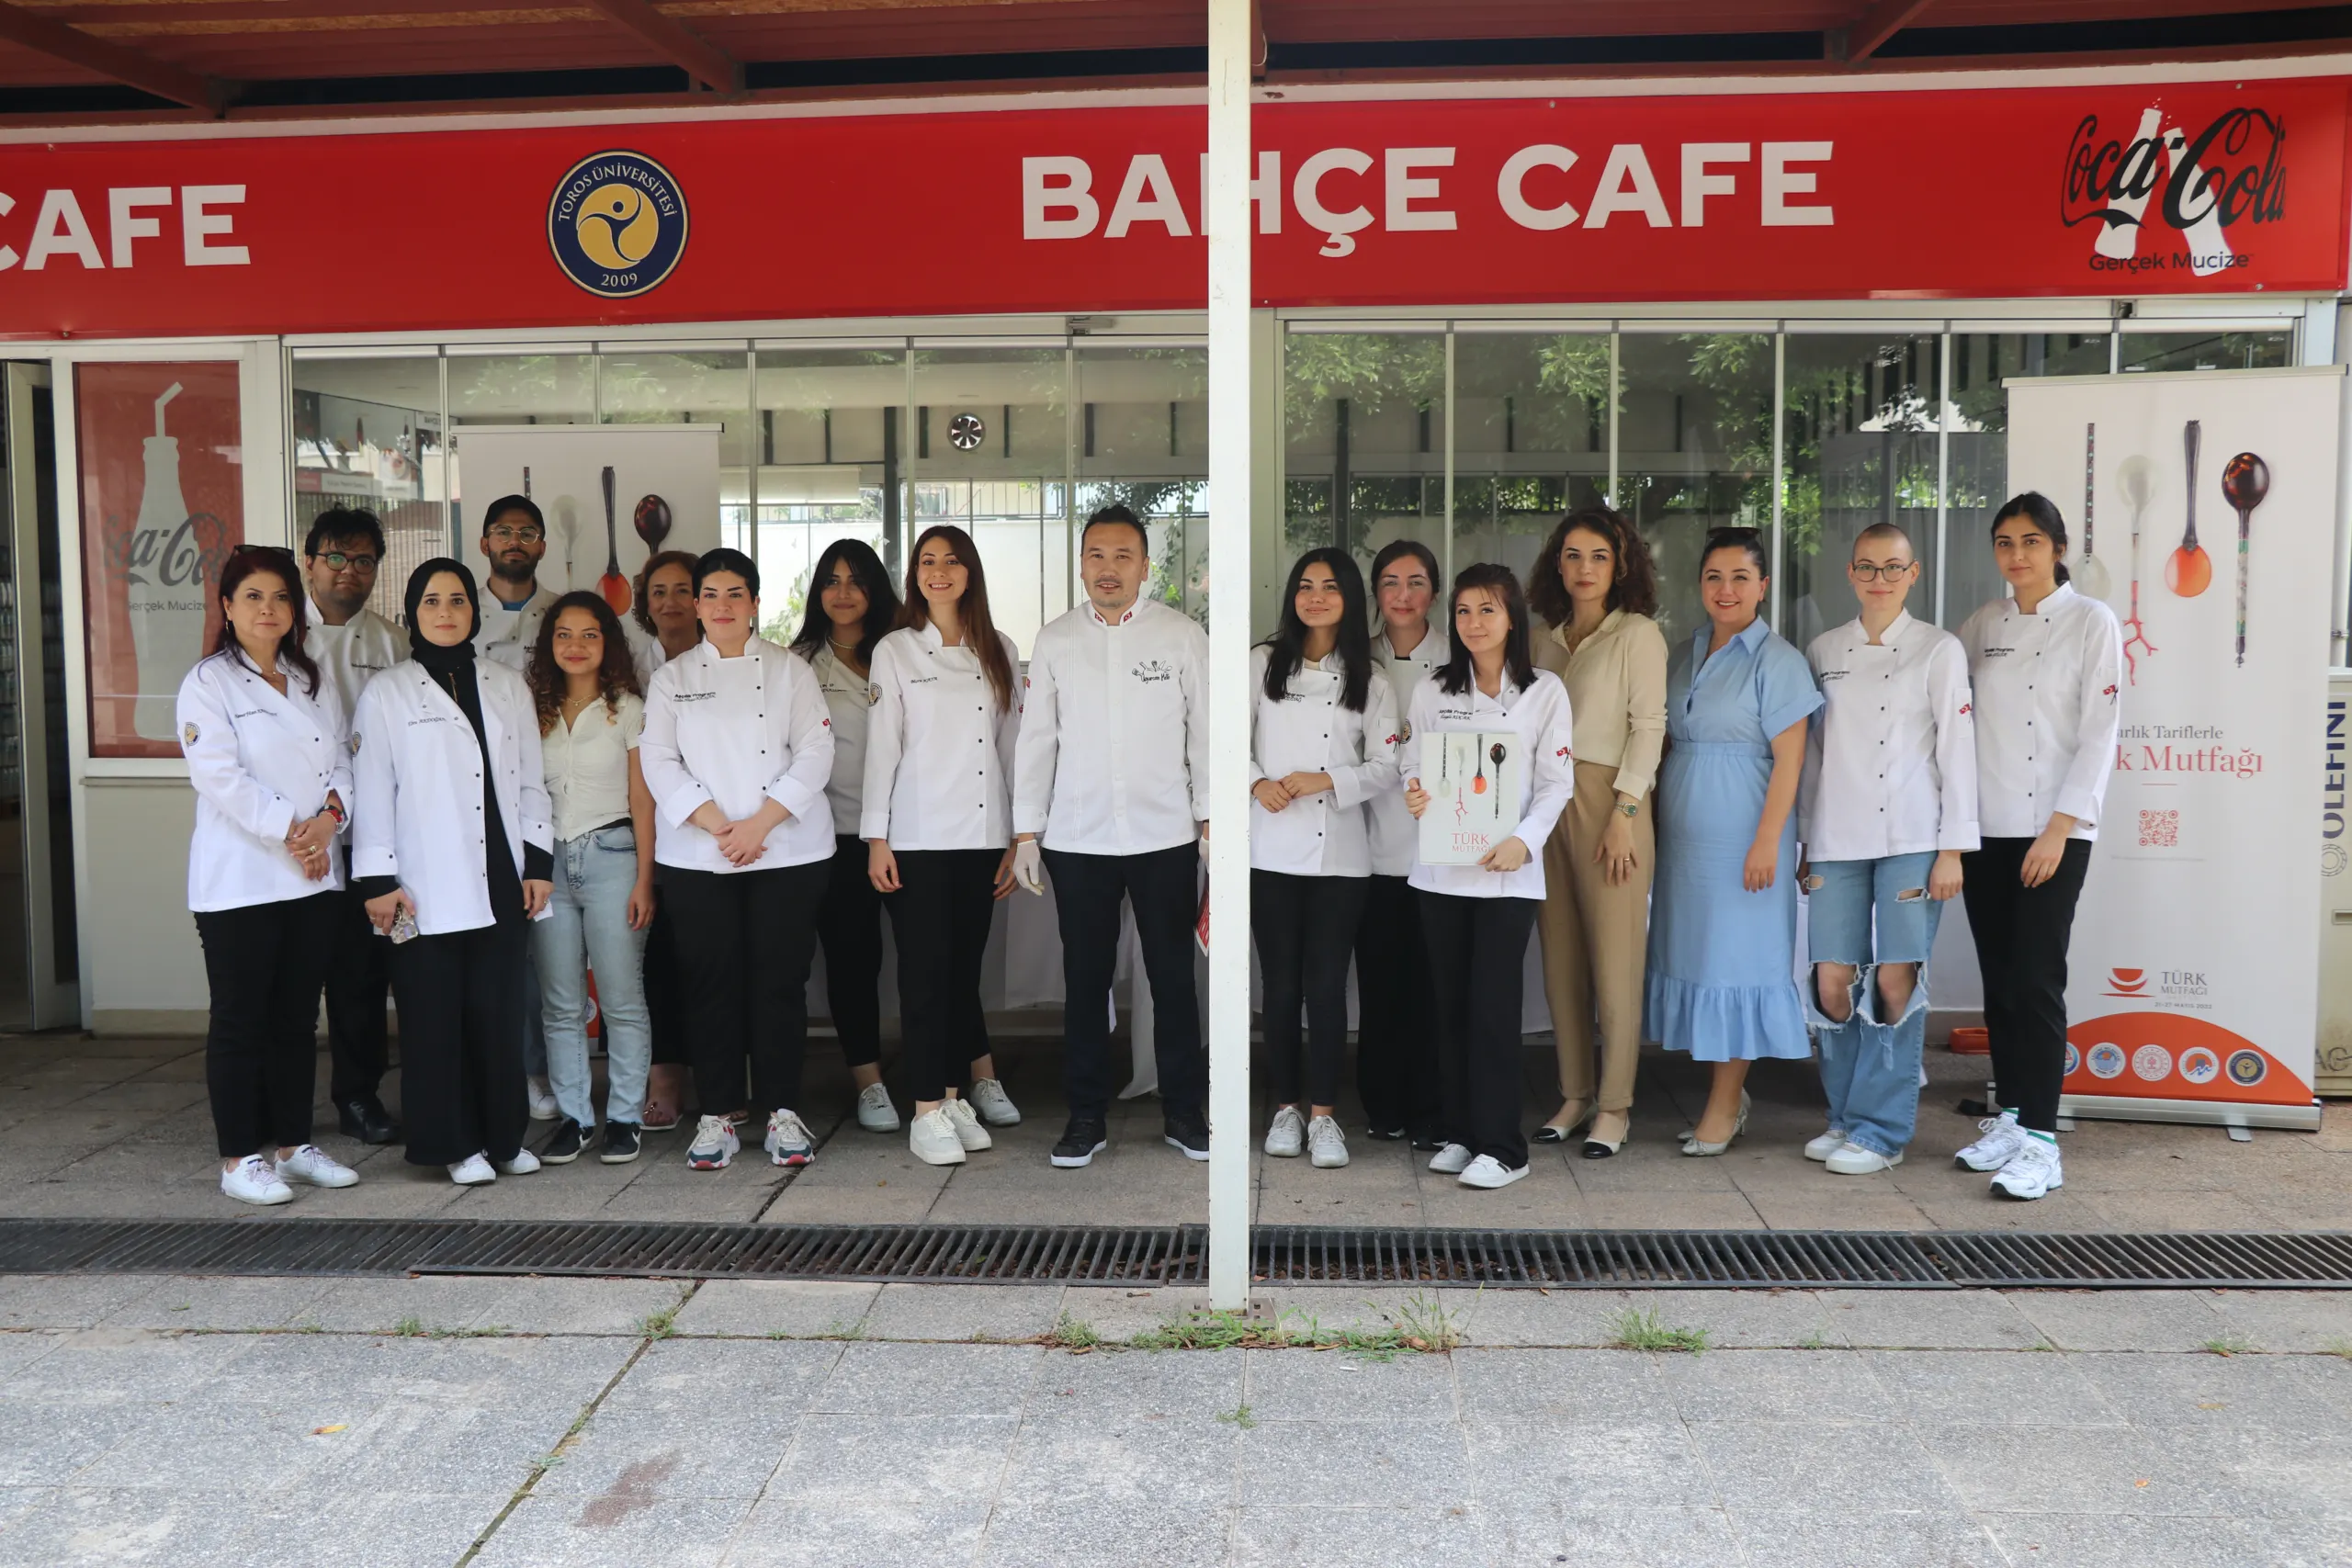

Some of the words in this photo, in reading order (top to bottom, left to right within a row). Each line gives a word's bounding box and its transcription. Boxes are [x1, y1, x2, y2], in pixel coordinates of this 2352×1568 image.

[558, 174, 593, 221] TOROS
[592, 163, 677, 217] ÜNİVERSİTESİ
[1497, 141, 1835, 231] CAFE
[0, 184, 251, 272] AFE
[2088, 254, 2165, 275] Gerçek
[2172, 251, 2250, 269] Mucize
[601, 273, 638, 287] 2009
[2117, 725, 2150, 739] ırlık
[2154, 725, 2224, 739] Tariflerle
[2141, 745, 2265, 779] Mutfağı
[1451, 831, 1490, 845] TÜRK
[2161, 967, 2208, 986] TÜRK
[2161, 986, 2208, 996] MUTFAĞI
